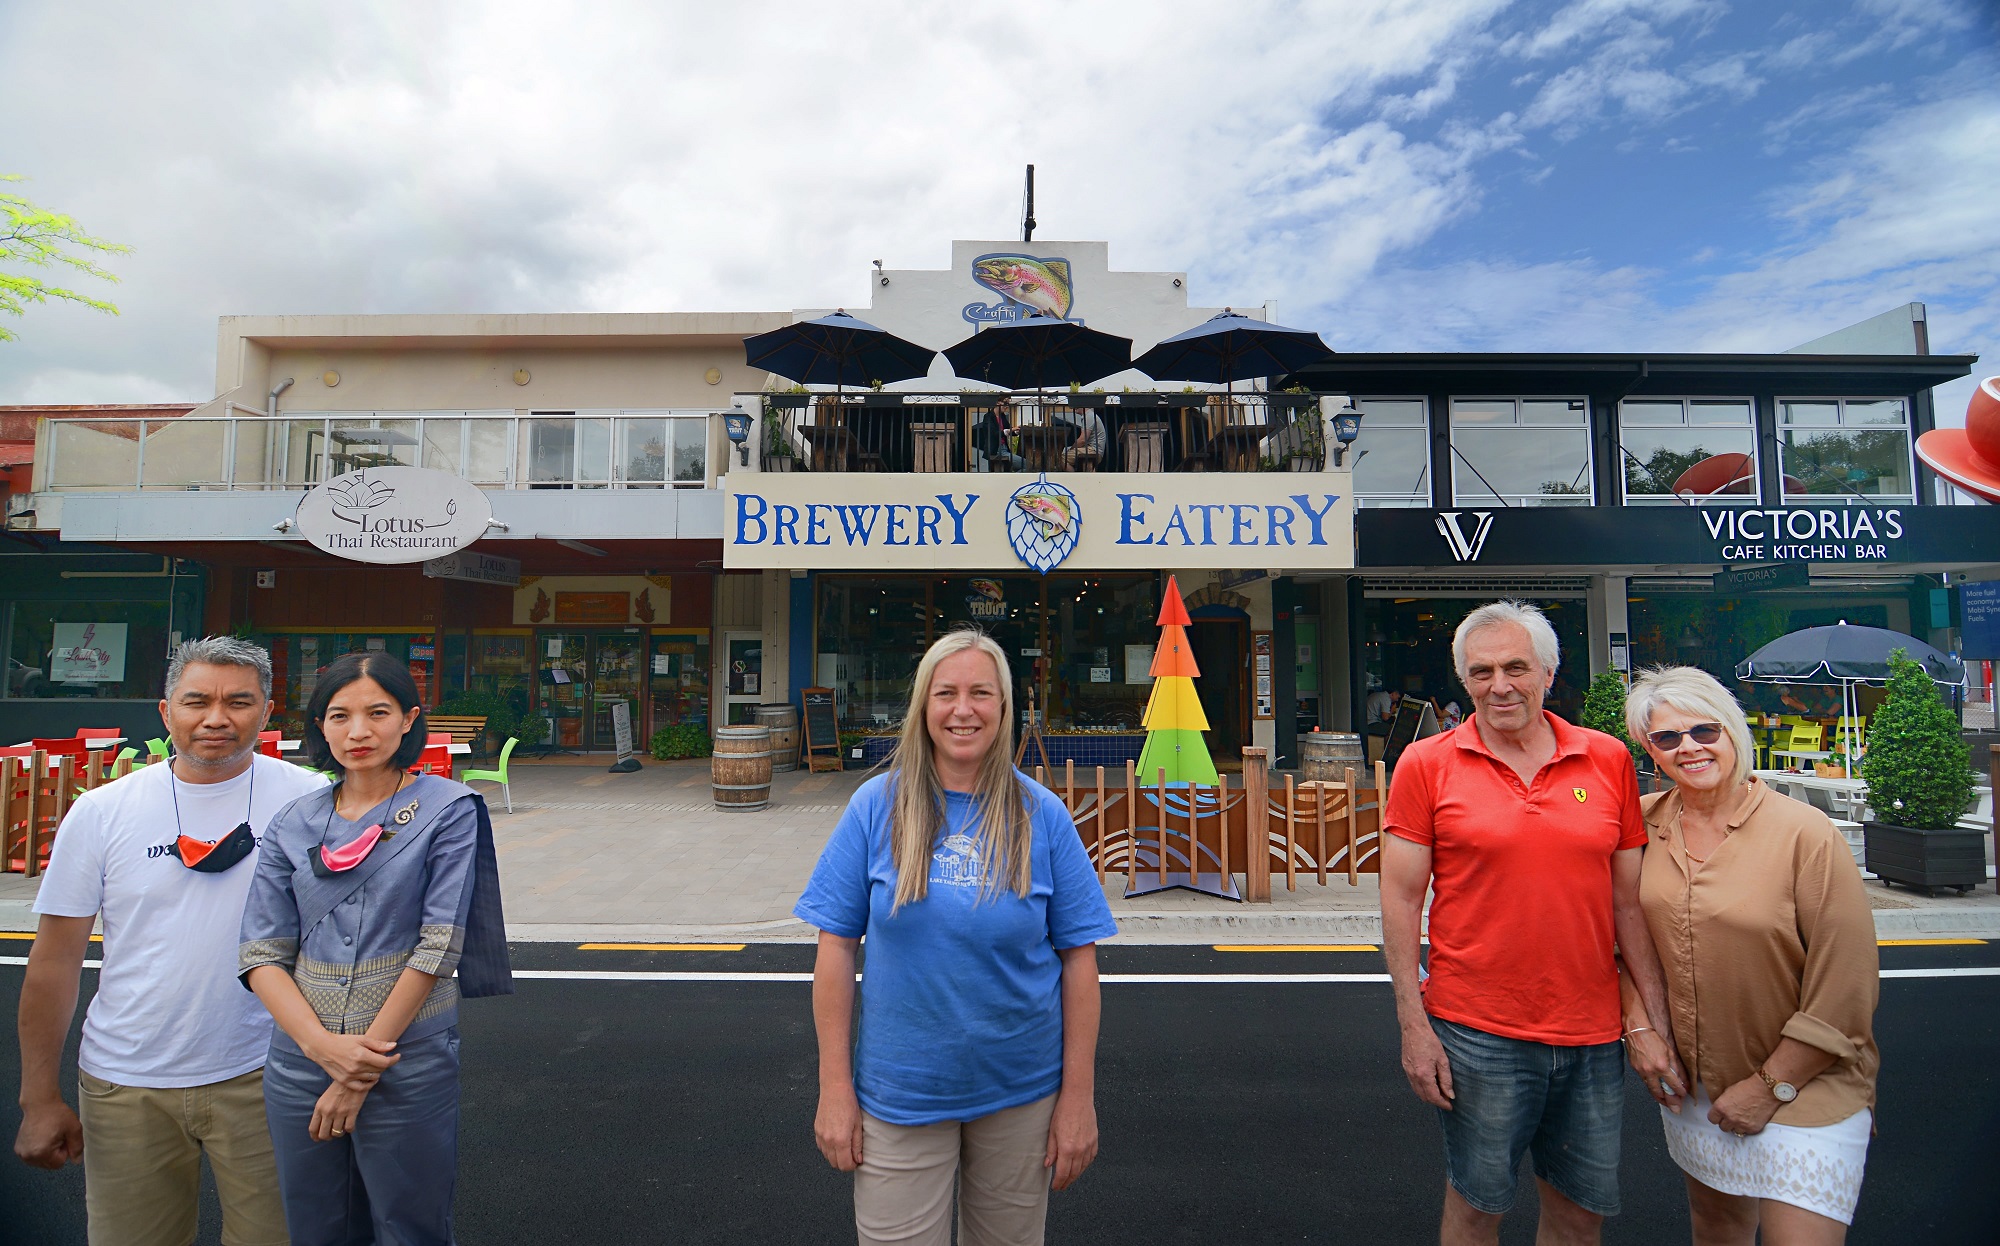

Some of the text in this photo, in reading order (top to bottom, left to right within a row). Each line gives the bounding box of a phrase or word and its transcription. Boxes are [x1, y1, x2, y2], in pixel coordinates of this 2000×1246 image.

[965, 306, 1017, 325] Crafty
[360, 513, 424, 533] Lotus
[733, 493, 981, 547] BREWERY
[1115, 493, 1341, 546] EATERY
[1701, 509, 1904, 540] VICTORIA'S
[326, 533, 458, 548] Thai Restaurant
[1435, 511, 1494, 561] V
[1722, 544, 1887, 559] CAFE KITCHEN BAR
[479, 555, 506, 573] Lotus
[464, 566, 519, 584] Thai Restaurant
[1727, 568, 1777, 583] VICTORIA'S
[970, 601, 1007, 616] TROUT
[1967, 606, 1986, 614] Mobil
